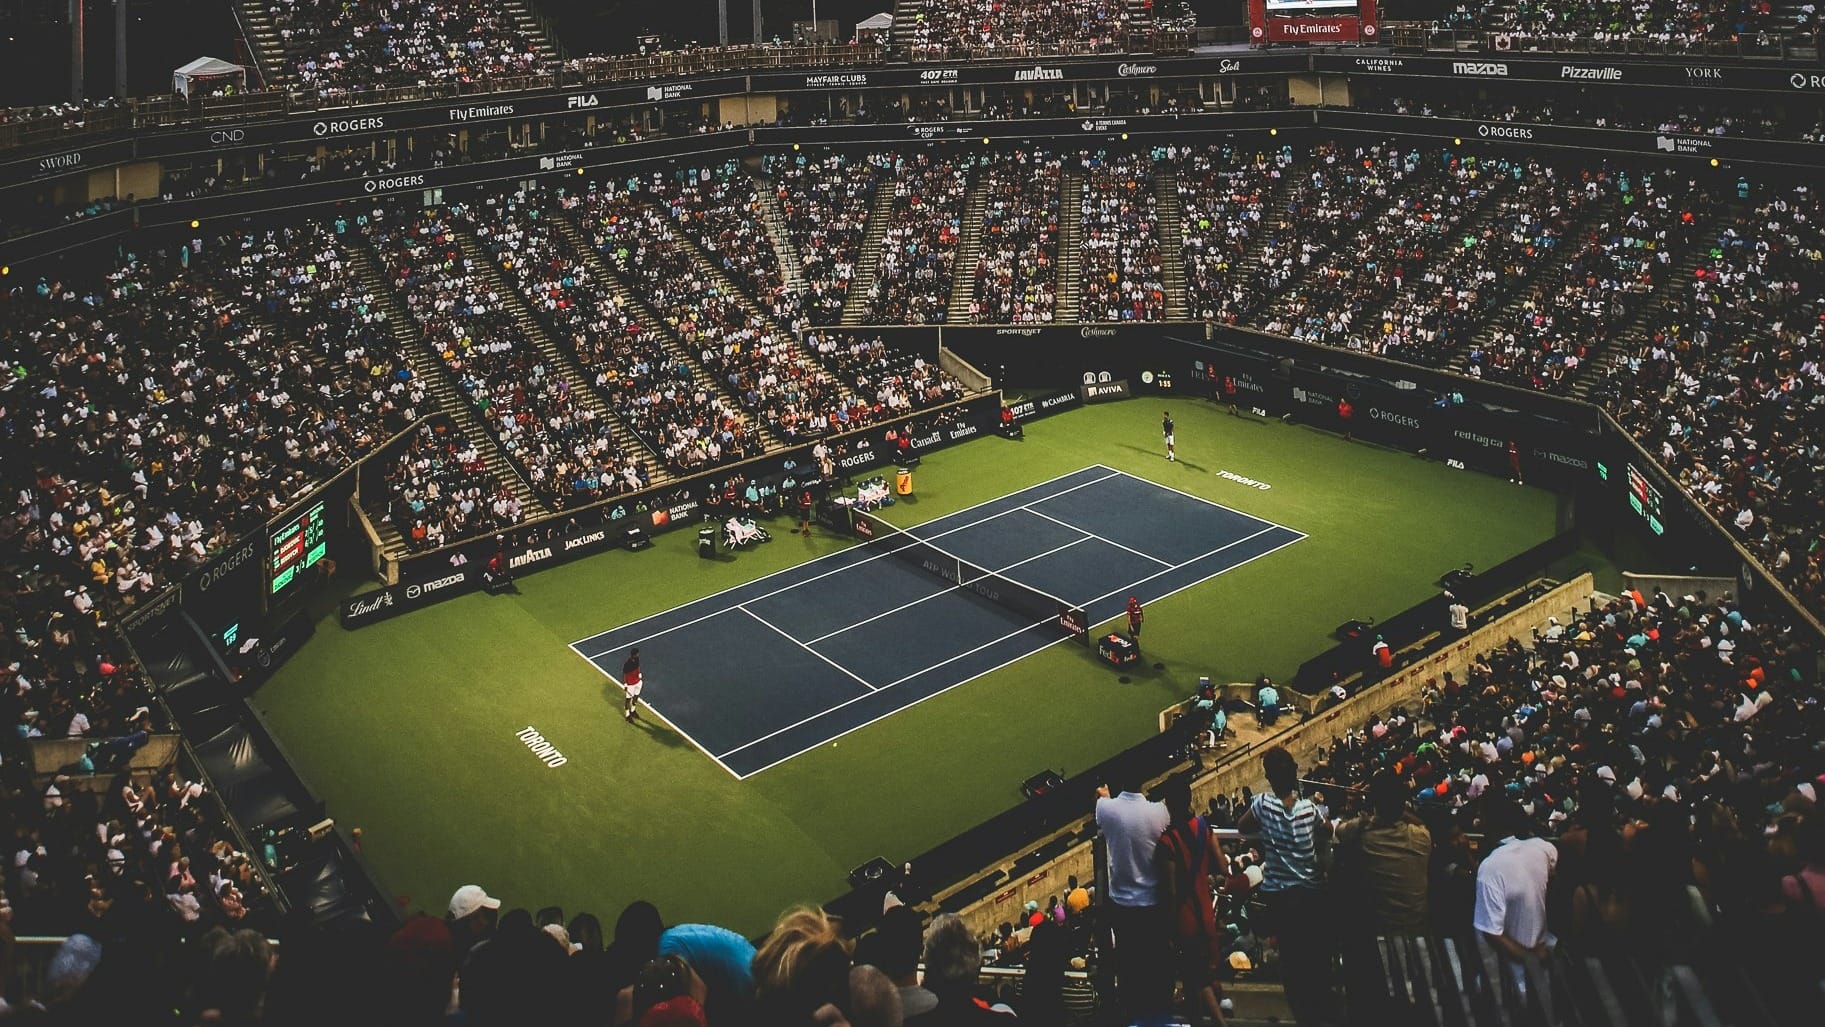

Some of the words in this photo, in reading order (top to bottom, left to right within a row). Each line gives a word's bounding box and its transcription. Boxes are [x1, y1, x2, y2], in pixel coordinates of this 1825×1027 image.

[1284, 24, 1299, 35] Fly
[1300, 23, 1341, 34] Emirates
[1219, 59, 1240, 73] Stoli
[1355, 58, 1403, 67] CALIFORNIA
[1367, 64, 1392, 72] WINES
[1453, 62, 1508, 76] mazda
[806, 75, 839, 84] MAYFAIR
[840, 74, 867, 82] CLUBS
[920, 70, 942, 80] 407
[1014, 66, 1064, 81] LAVAZZA
[1561, 66, 1622, 80] Pizzaville
[1685, 67, 1722, 78] YORK
[664, 84, 693, 92] NATIONAL
[664, 91, 681, 99] BANK
[567, 95, 599, 109] FILA
[449, 109, 468, 121] Fly
[468, 104, 514, 118] Emirates
[330, 116, 384, 133] ROGERS
[210, 129, 245, 144] CND
[1490, 126, 1533, 139] ROGERS
[1677, 138, 1712, 147] NATIONAL
[1677, 145, 1698, 153] BANK
[39, 152, 81, 171] SWORD
[555, 153, 583, 163] NATIONAL
[556, 159, 573, 168] BANK
[378, 175, 424, 190] ROGERS
[996, 328, 1042, 336] SPORTSNET
[1098, 385, 1123, 395] AVIVA
[1307, 391, 1334, 403] NATIONAL
[1048, 392, 1076, 406] CAMBRIA
[1252, 406, 1266, 417] FILA
[956, 421, 966, 430] Fly
[1381, 410, 1420, 429] ROGERS
[910, 430, 943, 449] Canada
[949, 425, 977, 440] Emirates
[841, 450, 875, 468] ROGERS
[1447, 458, 1465, 470] FILA
[1549, 452, 1588, 469] mazda
[1215, 470, 1272, 490] TORONTO
[669, 501, 699, 515] NATIONAL
[670, 510, 688, 521] BANK
[564, 537, 584, 551] JACK
[213, 542, 254, 582] ROGERS
[509, 547, 553, 569] LAVAZZA
[423, 572, 465, 593] mazda
[975, 582, 1000, 600] TOUR
[348, 597, 383, 618] Lindt
[515, 725, 568, 768] TORONTO
